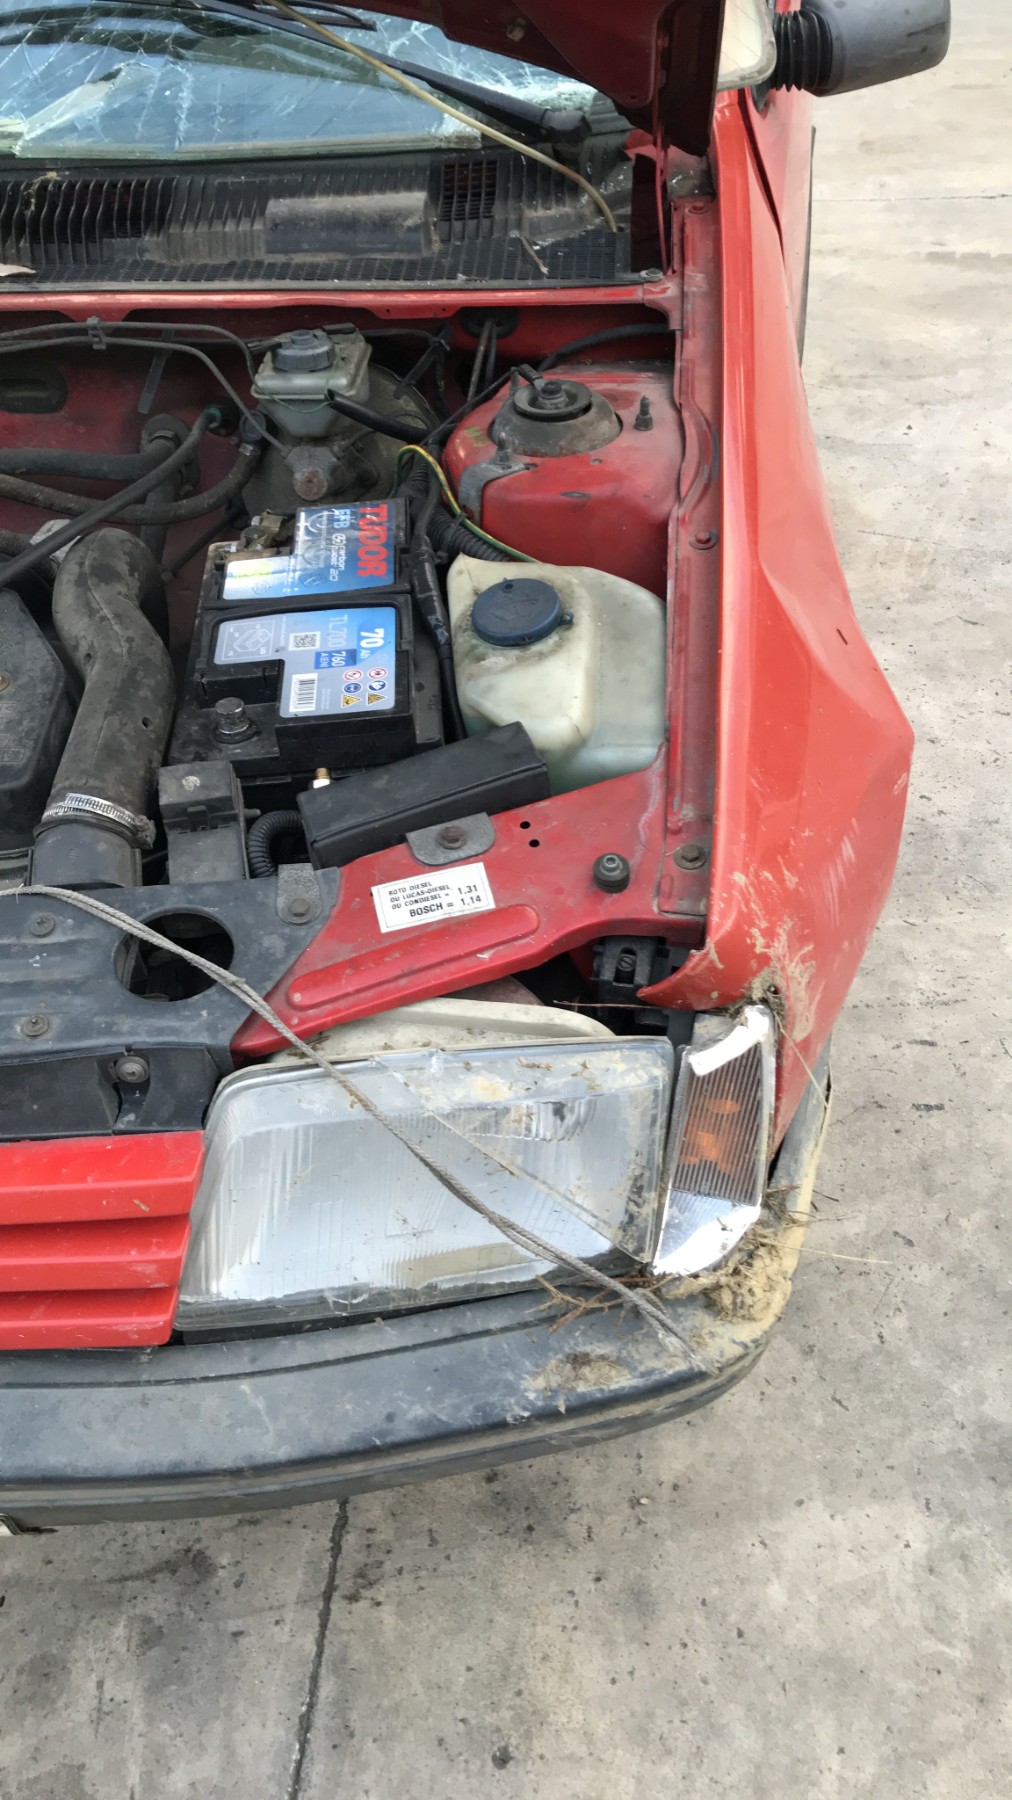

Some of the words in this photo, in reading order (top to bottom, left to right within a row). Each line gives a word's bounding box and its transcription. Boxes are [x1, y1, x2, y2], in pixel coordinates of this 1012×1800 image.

[357, 503, 388, 577] TUDOR
[327, 614, 348, 648] TL700
[360, 628, 384, 648] 70
[331, 651, 346, 667] 760
[388, 886, 407, 896] ROTO
[409, 881, 433, 891] DIESEL
[390, 895, 400, 903] OU
[402, 884, 450, 900] LUCAS-DIESEL
[404, 893, 441, 907] CONDIESEL
[409, 902, 444, 917] BOSCH
